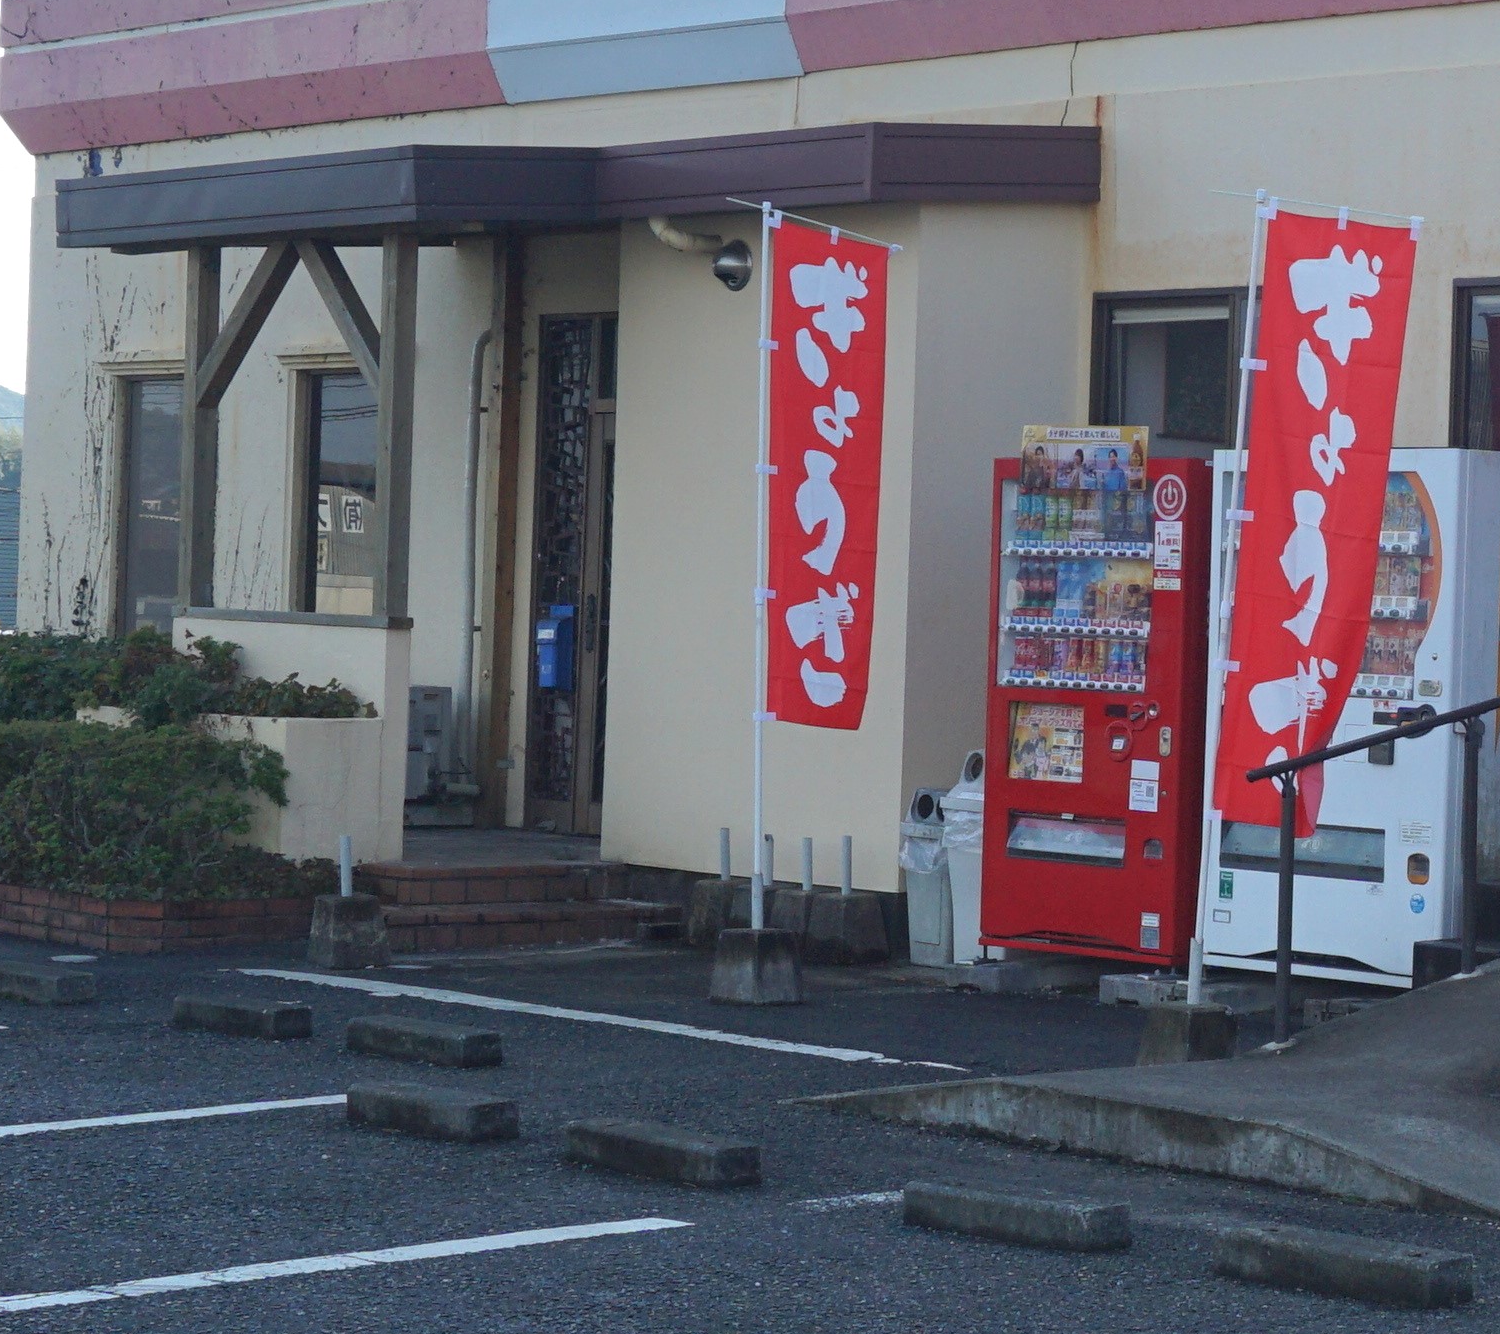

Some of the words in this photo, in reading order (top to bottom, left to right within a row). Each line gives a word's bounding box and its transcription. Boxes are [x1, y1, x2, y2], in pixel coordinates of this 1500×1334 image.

[786, 256, 869, 708] ぎょうざ
[1248, 244, 1385, 797] ぎょうざ
